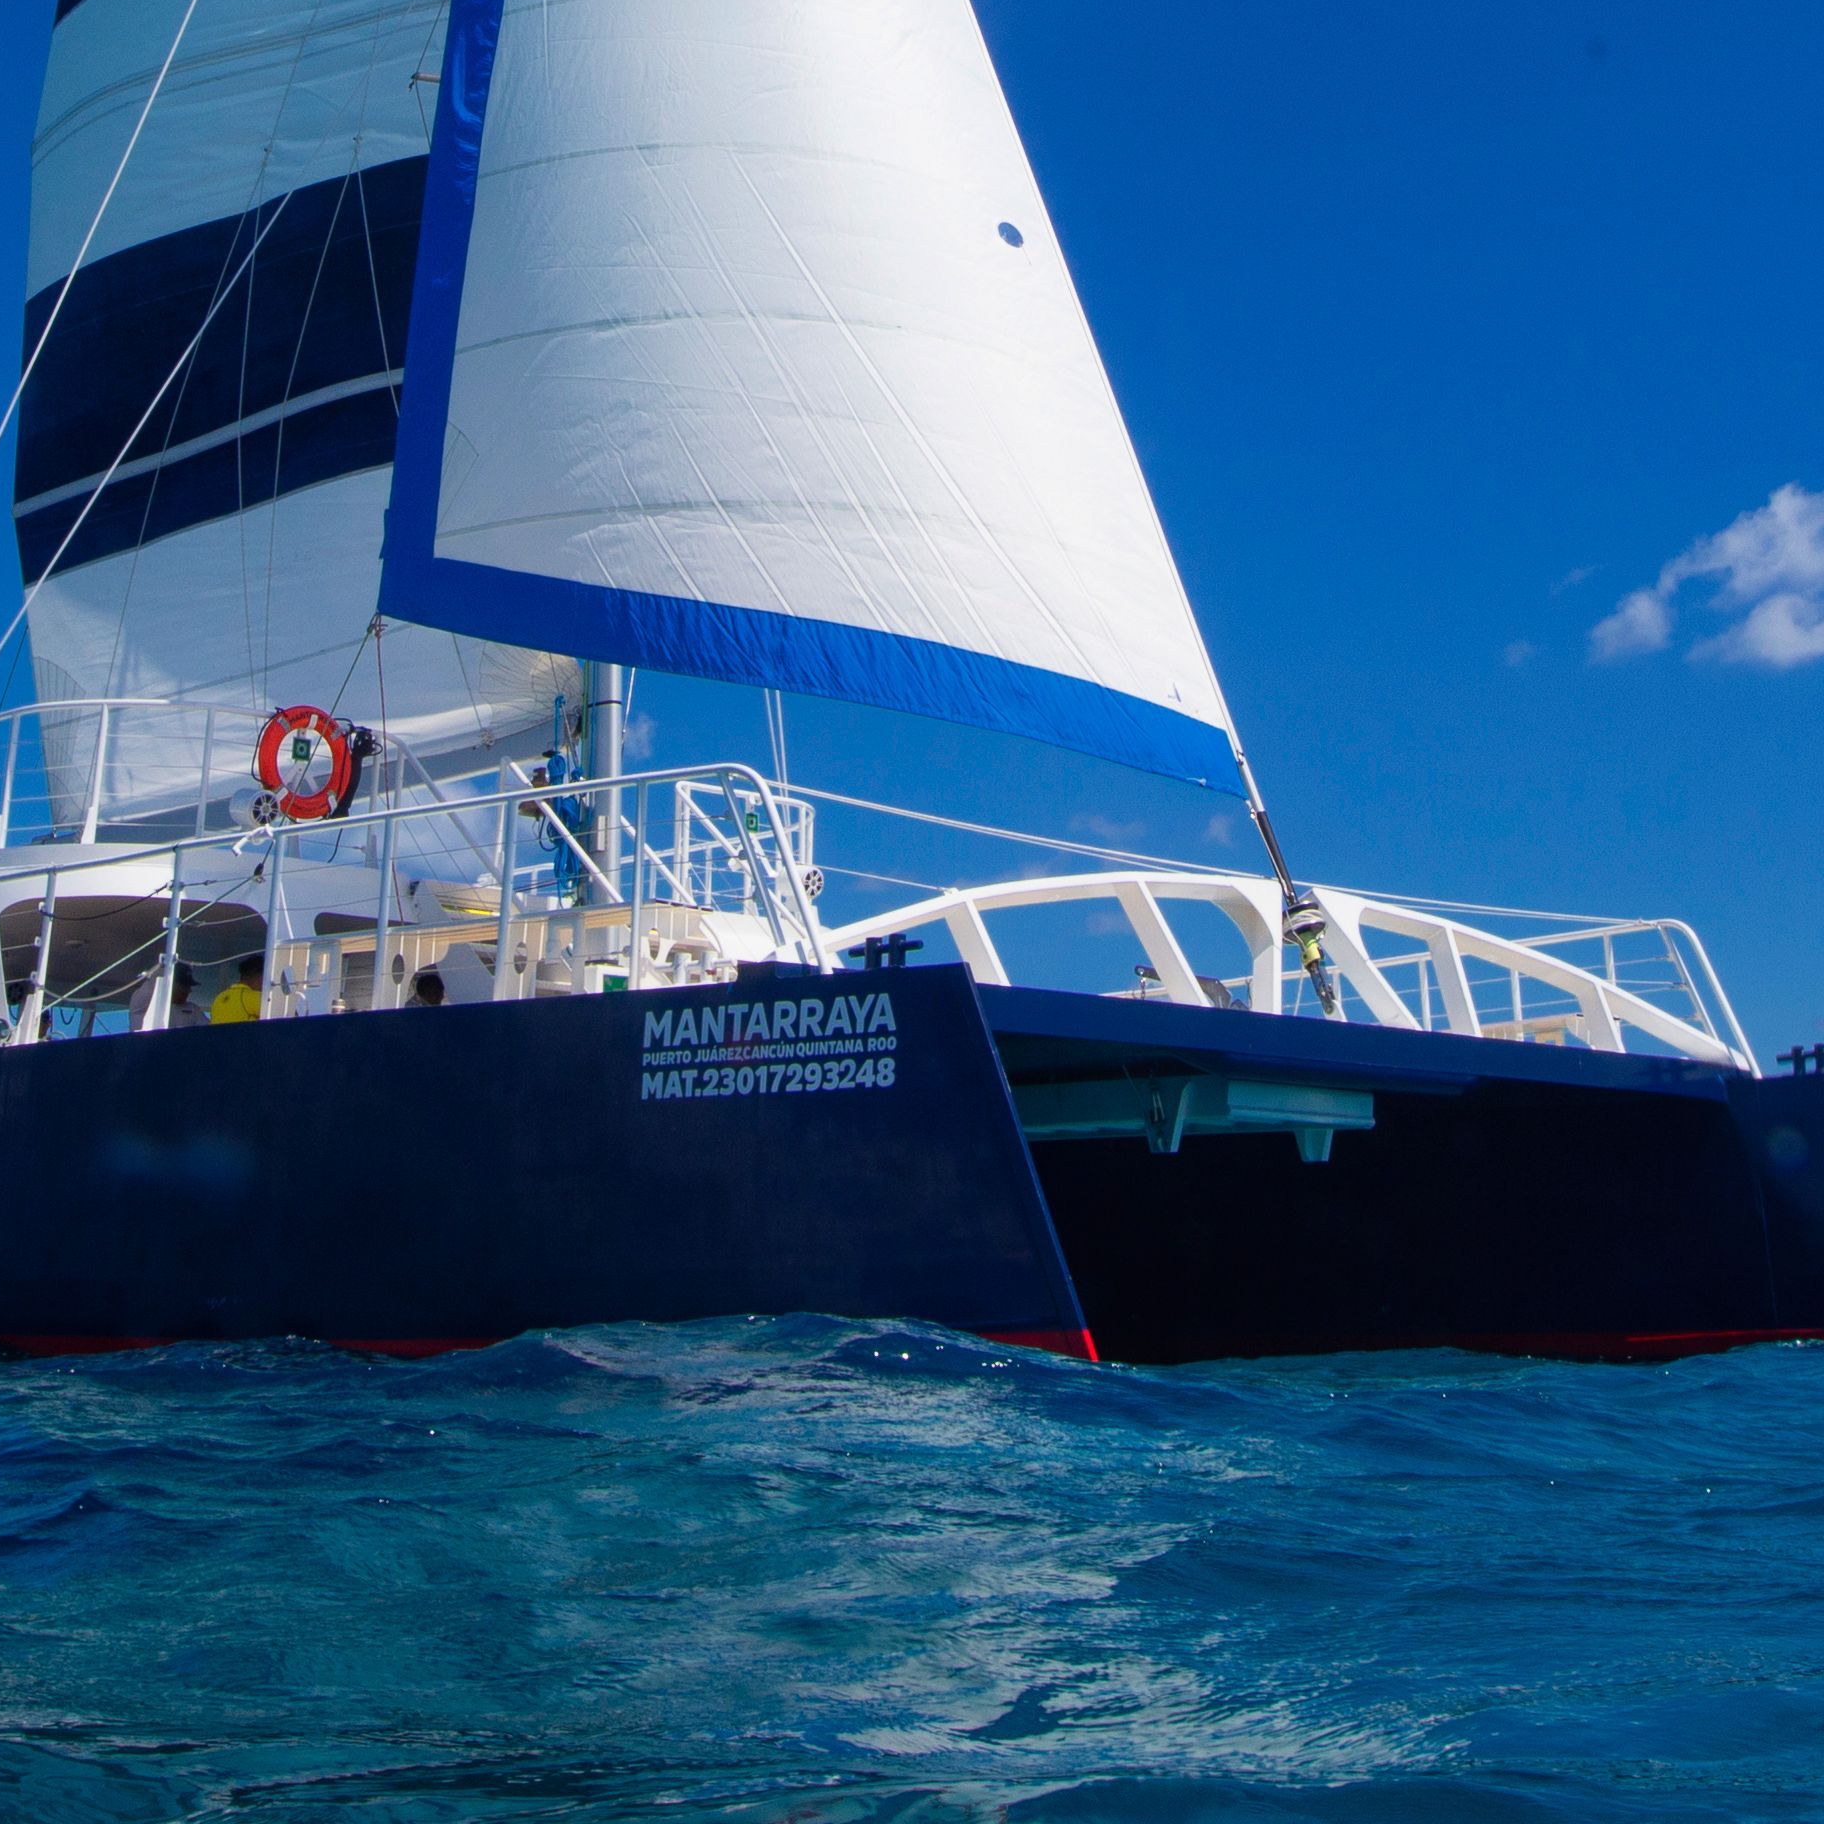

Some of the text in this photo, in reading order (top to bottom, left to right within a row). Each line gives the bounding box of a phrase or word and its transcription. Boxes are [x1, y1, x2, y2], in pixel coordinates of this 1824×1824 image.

[643, 993, 896, 1048] MANTARRAYA
[642, 1050, 692, 1067] PUERTO
[796, 1039, 864, 1057] QUINTANA
[867, 1036, 897, 1052] ROO
[641, 1057, 895, 1100] MAT.23017293248
